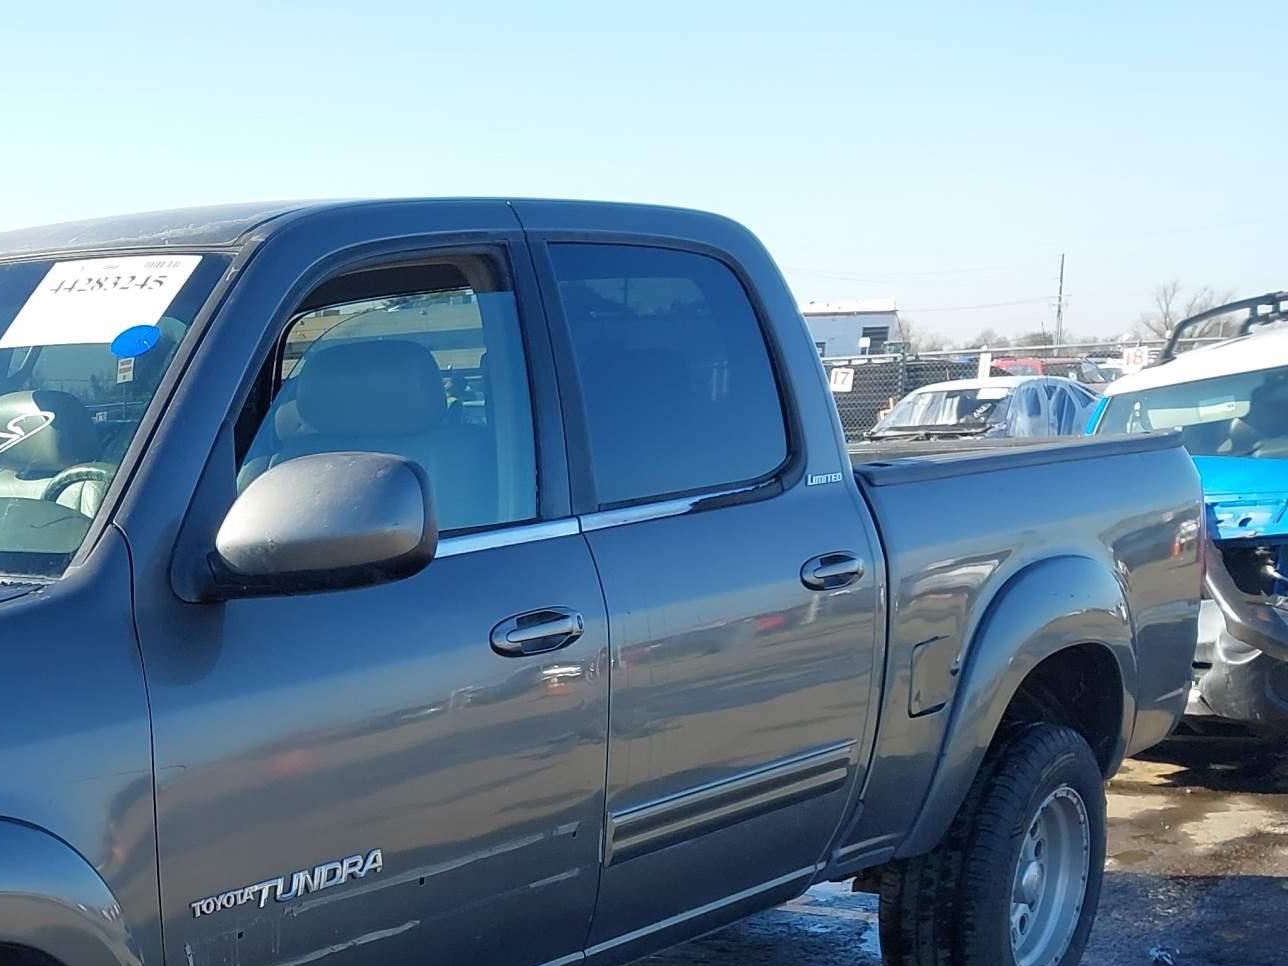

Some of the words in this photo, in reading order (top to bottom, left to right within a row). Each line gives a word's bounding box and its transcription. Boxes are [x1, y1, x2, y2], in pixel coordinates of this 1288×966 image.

[49, 275, 169, 294] 44283245
[833, 370, 850, 385] 17
[192, 886, 261, 918] TOYOTA
[257, 848, 384, 908] TUNDRA
